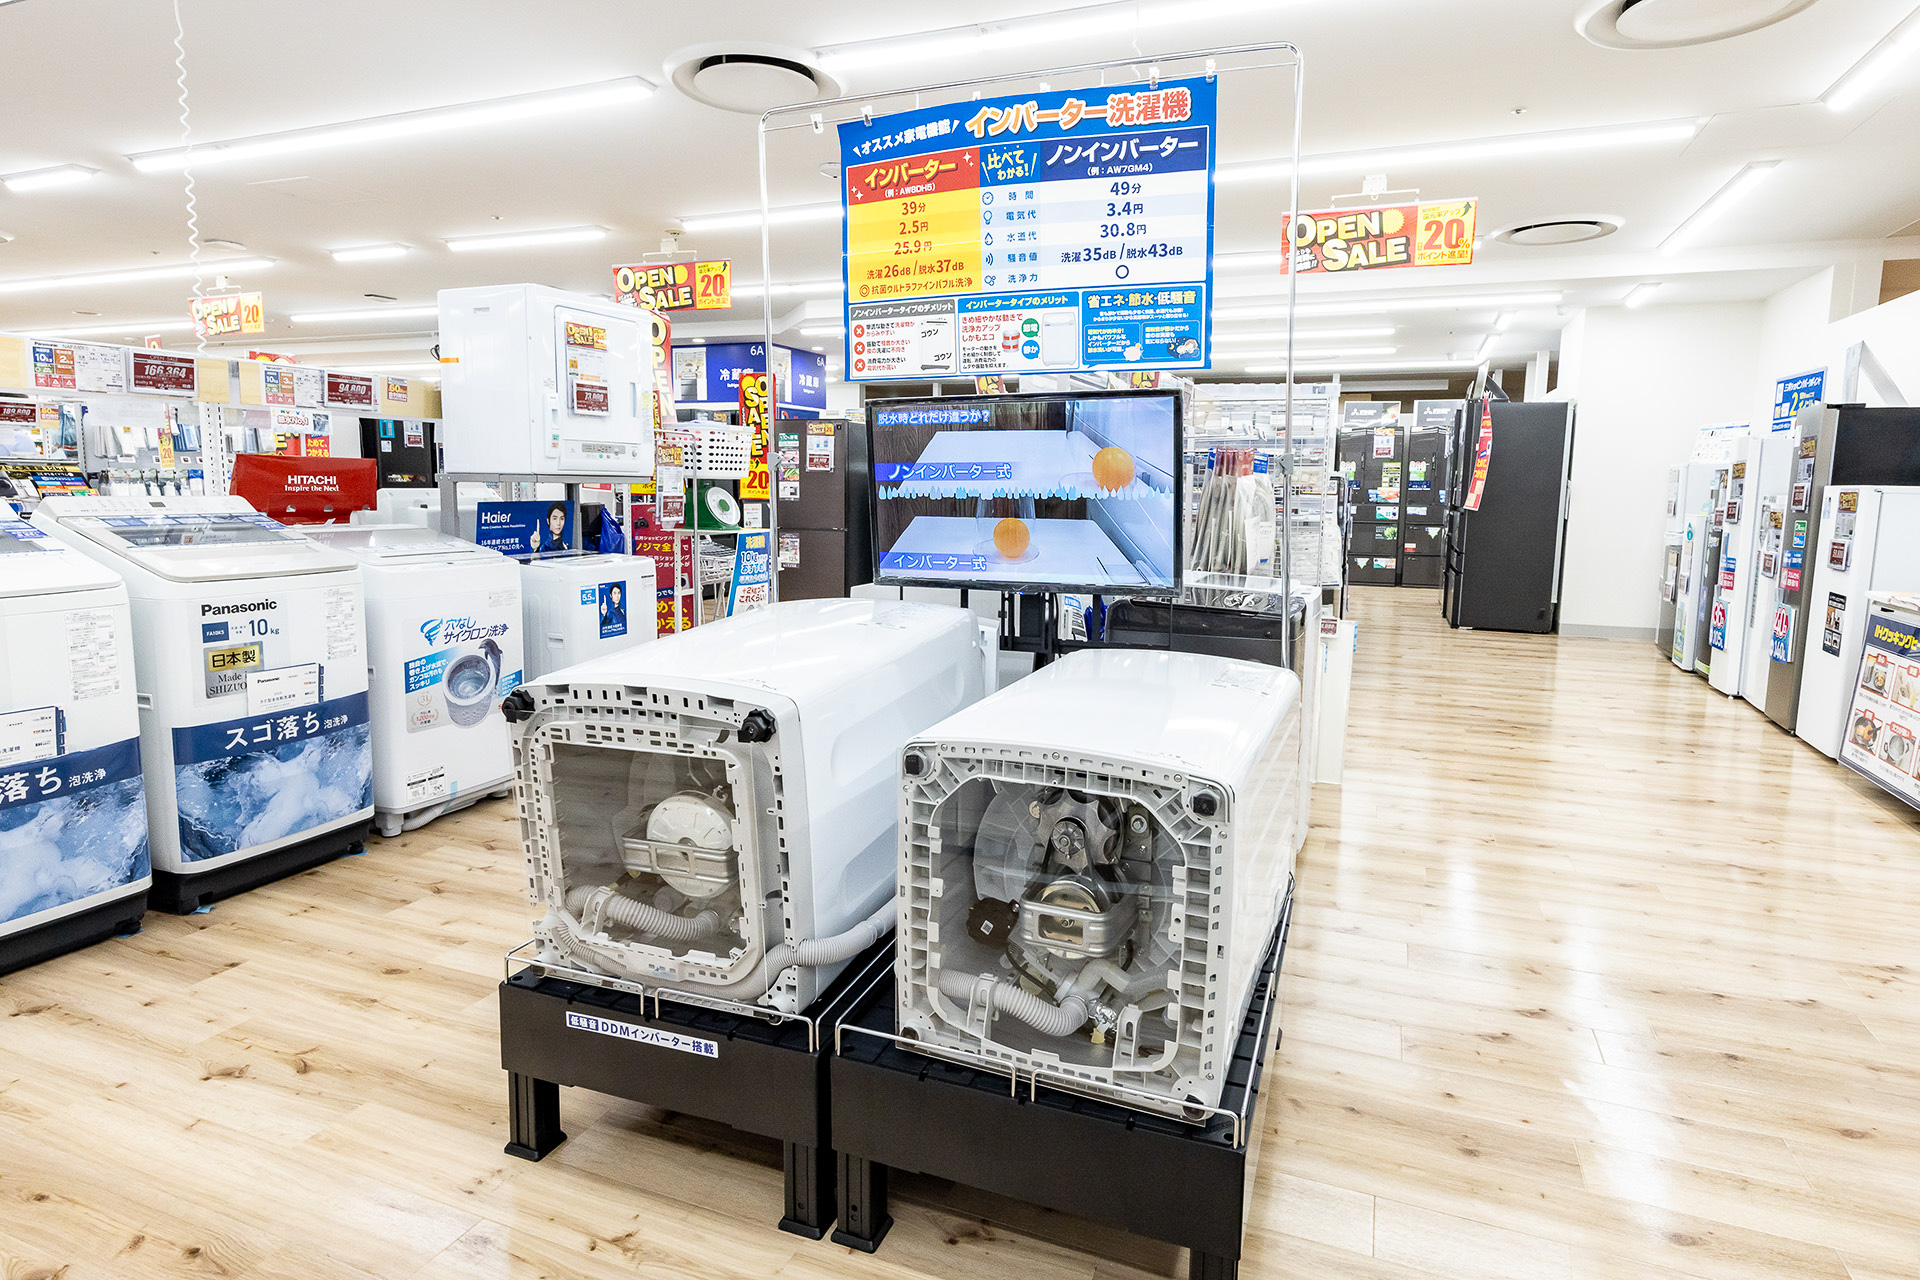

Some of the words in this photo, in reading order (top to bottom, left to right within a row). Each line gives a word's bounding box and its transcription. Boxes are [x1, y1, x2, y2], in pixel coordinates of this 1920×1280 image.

[966, 88, 1190, 138] インバーター洗濯機
[861, 119, 951, 155] オススメ家電機能
[1046, 136, 1198, 166] ノンインバーター
[987, 149, 1025, 170] 比べて
[865, 159, 957, 189] インバーター
[997, 163, 1030, 181] わかる!
[1008, 190, 1034, 201] 時間
[1110, 181, 1141, 196] 49分
[902, 202, 926, 216] 39分
[1006, 210, 1037, 221] 電気代
[1106, 202, 1143, 217] 3.4円
[899, 220, 929, 236] 2.5円
[1100, 223, 1147, 239] 30.8円
[1287, 211, 1384, 248] OPEN
[1424, 218, 1470, 250] 20%
[894, 240, 932, 256] 25.9円
[1322, 238, 1409, 271] SALE
[1008, 253, 1038, 263] 騒音値
[617, 265, 675, 293] OPEN
[1008, 273, 1038, 284] 洗浄力
[639, 285, 693, 311] SALE
[965, 295, 1069, 310] インバータータイプのメリット
[192, 299, 229, 320] OPEN
[853, 302, 954, 318] ノンインバータータイプのデメリット
[206, 315, 241, 336] SALE
[962, 313, 1023, 325] きめ細やかな動きで
[920, 329, 939, 339] ゴウン
[962, 323, 1001, 333] 洗浄力アップ
[962, 333, 995, 342] しかもエコ
[750, 345, 765, 356] 6A
[933, 352, 953, 362] ゴウン
[816, 357, 825, 366] 6A
[144, 364, 186, 378] 166,364
[338, 383, 367, 395] 94,800
[877, 409, 990, 426] 脱水時どれだけ違うか?
[307, 438, 328, 448] ためて、
[307, 448, 330, 458] つかえる
[887, 462, 1012, 480] ノンインバーター式
[288, 475, 337, 485] HITACHI
[746, 470, 769, 489] 20
[481, 511, 512, 524] Haier
[636, 542, 689, 552] ノジマ全で
[893, 554, 988, 571] インバーター式
[201, 599, 278, 617] Panasonic
[446, 616, 477, 631] 穴なし
[657, 617, 692, 630] かえる
[443, 624, 509, 645] サイクロン洗浄
[211, 649, 256, 668] 日本製
[218, 673, 242, 683] Made
[409, 679, 431, 691] スッキリ
[209, 684, 248, 696] SHIZUO
[225, 710, 320, 750] スゴ落ち
[323, 714, 349, 730] 泡洗浄
[0, 766, 62, 803] 落ち
[68, 768, 107, 788] 泡洗浄
[601, 1021, 714, 1055] DDMインバーター搭載
